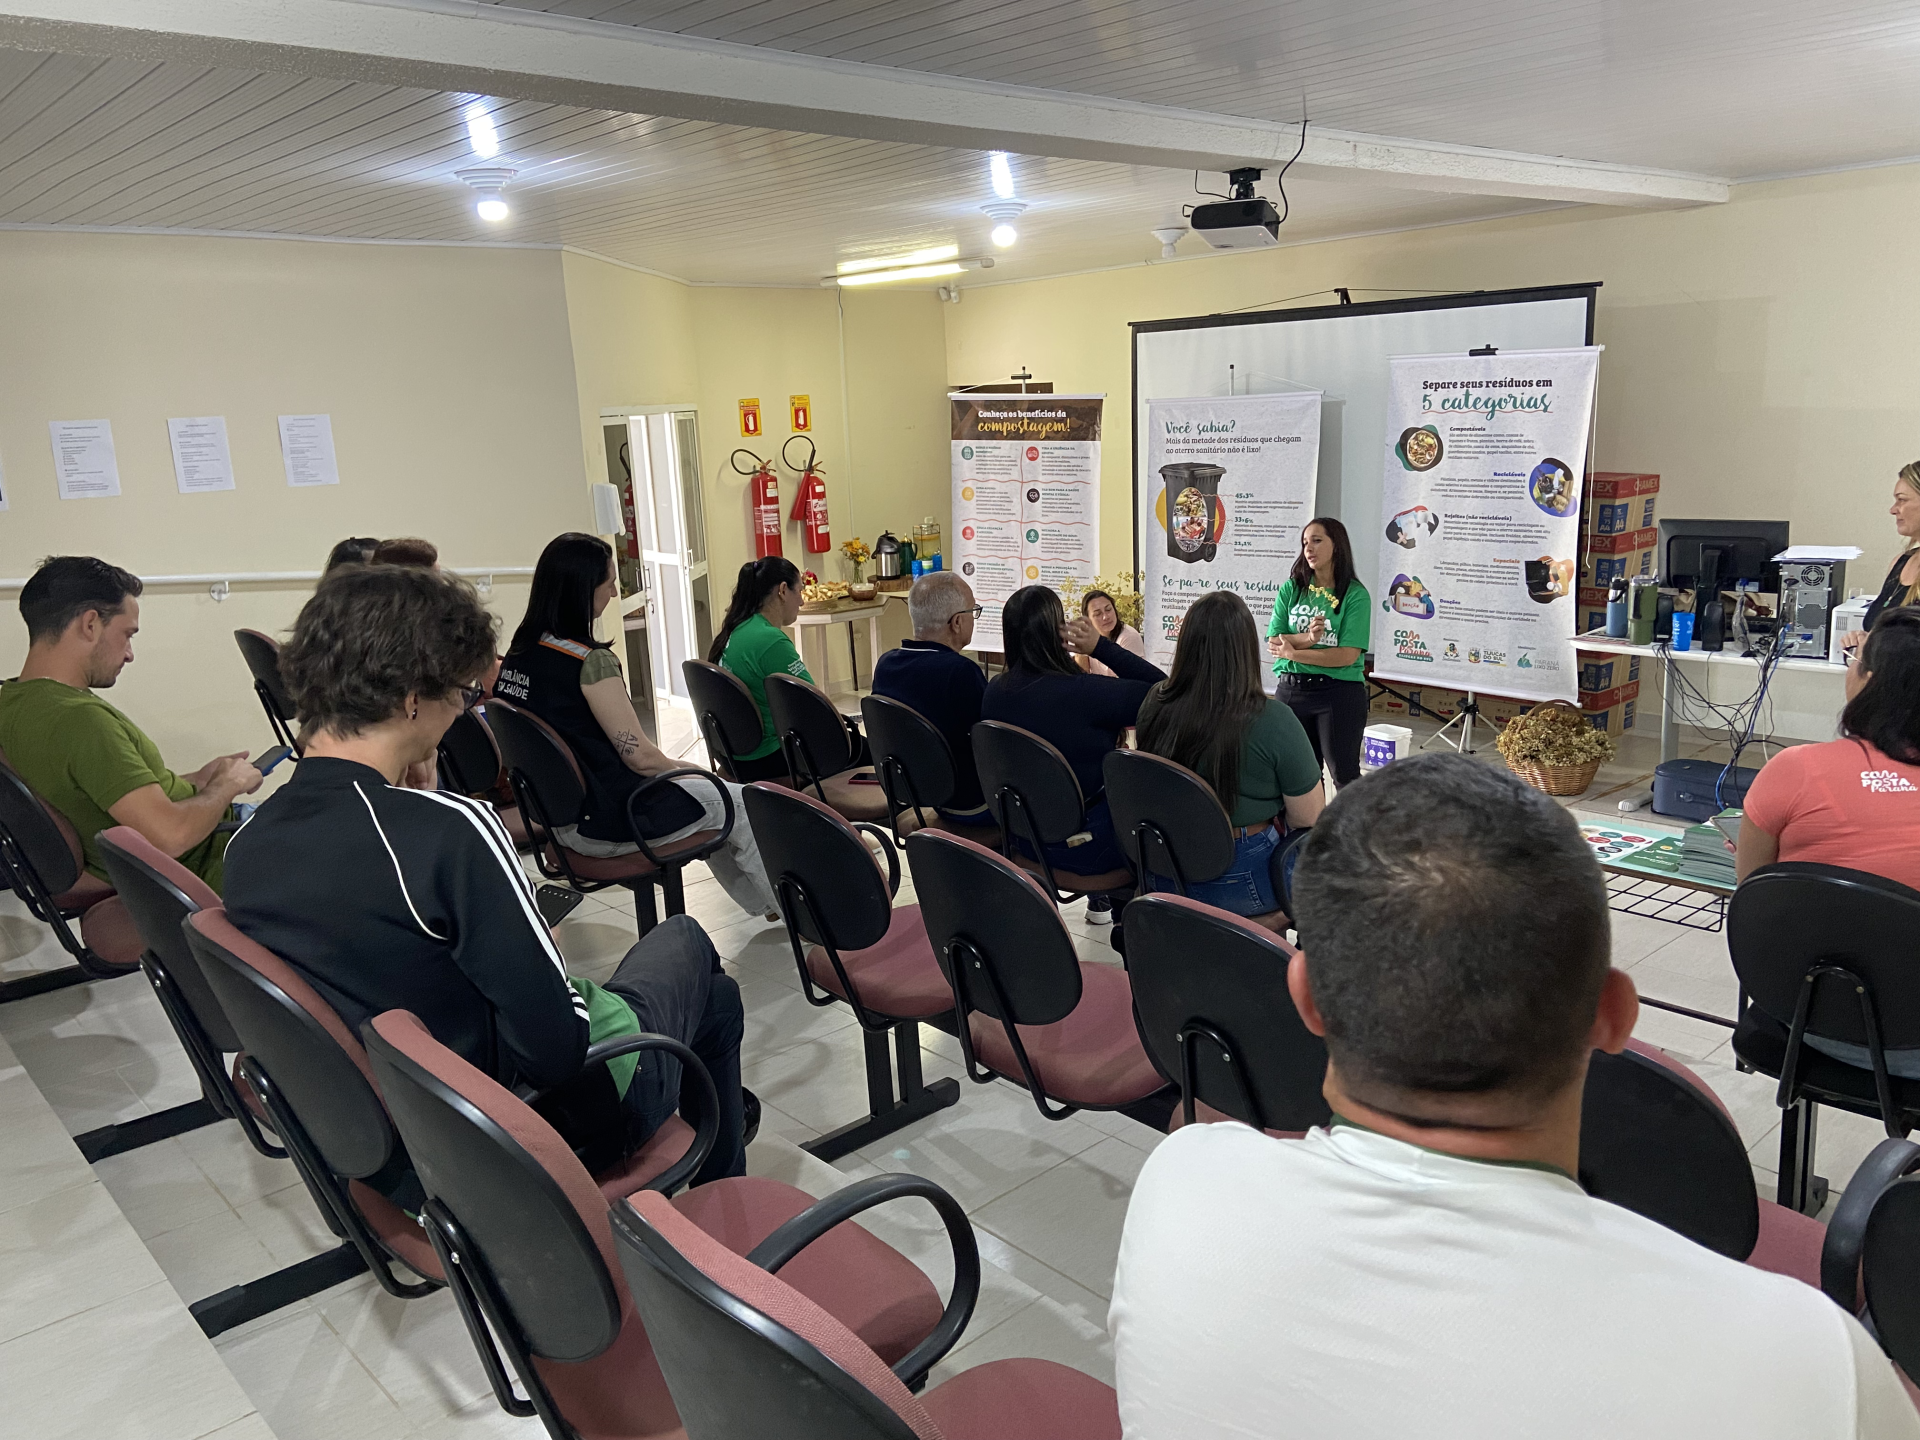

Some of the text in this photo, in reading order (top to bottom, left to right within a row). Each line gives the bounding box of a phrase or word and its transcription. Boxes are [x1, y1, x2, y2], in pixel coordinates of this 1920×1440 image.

[1422, 377, 1553, 391] Separe seus resíduos em
[1422, 389, 1552, 421] 5 categorias
[978, 410, 1008, 419] Conheça
[1018, 409, 1056, 418] benefícios
[1056, 410, 1066, 418] da
[978, 417, 1070, 439] compostagem!
[1165, 420, 1236, 435] Você sabia?
[1230, 436, 1259, 444] resíduos
[1274, 435, 1301, 444] chegam
[1196, 446, 1226, 454] sanitário
[1163, 575, 1280, 592] Se-pa-re seus resídu
[1288, 615, 1332, 630] POA
[1394, 630, 1420, 640] COM
[1394, 638, 1427, 650] POSTA
[504, 683, 529, 700] SAÚDE
[1860, 770, 1897, 779] COM
[1861, 778, 1910, 787] POSTA
[1871, 783, 1918, 793] Paraná
